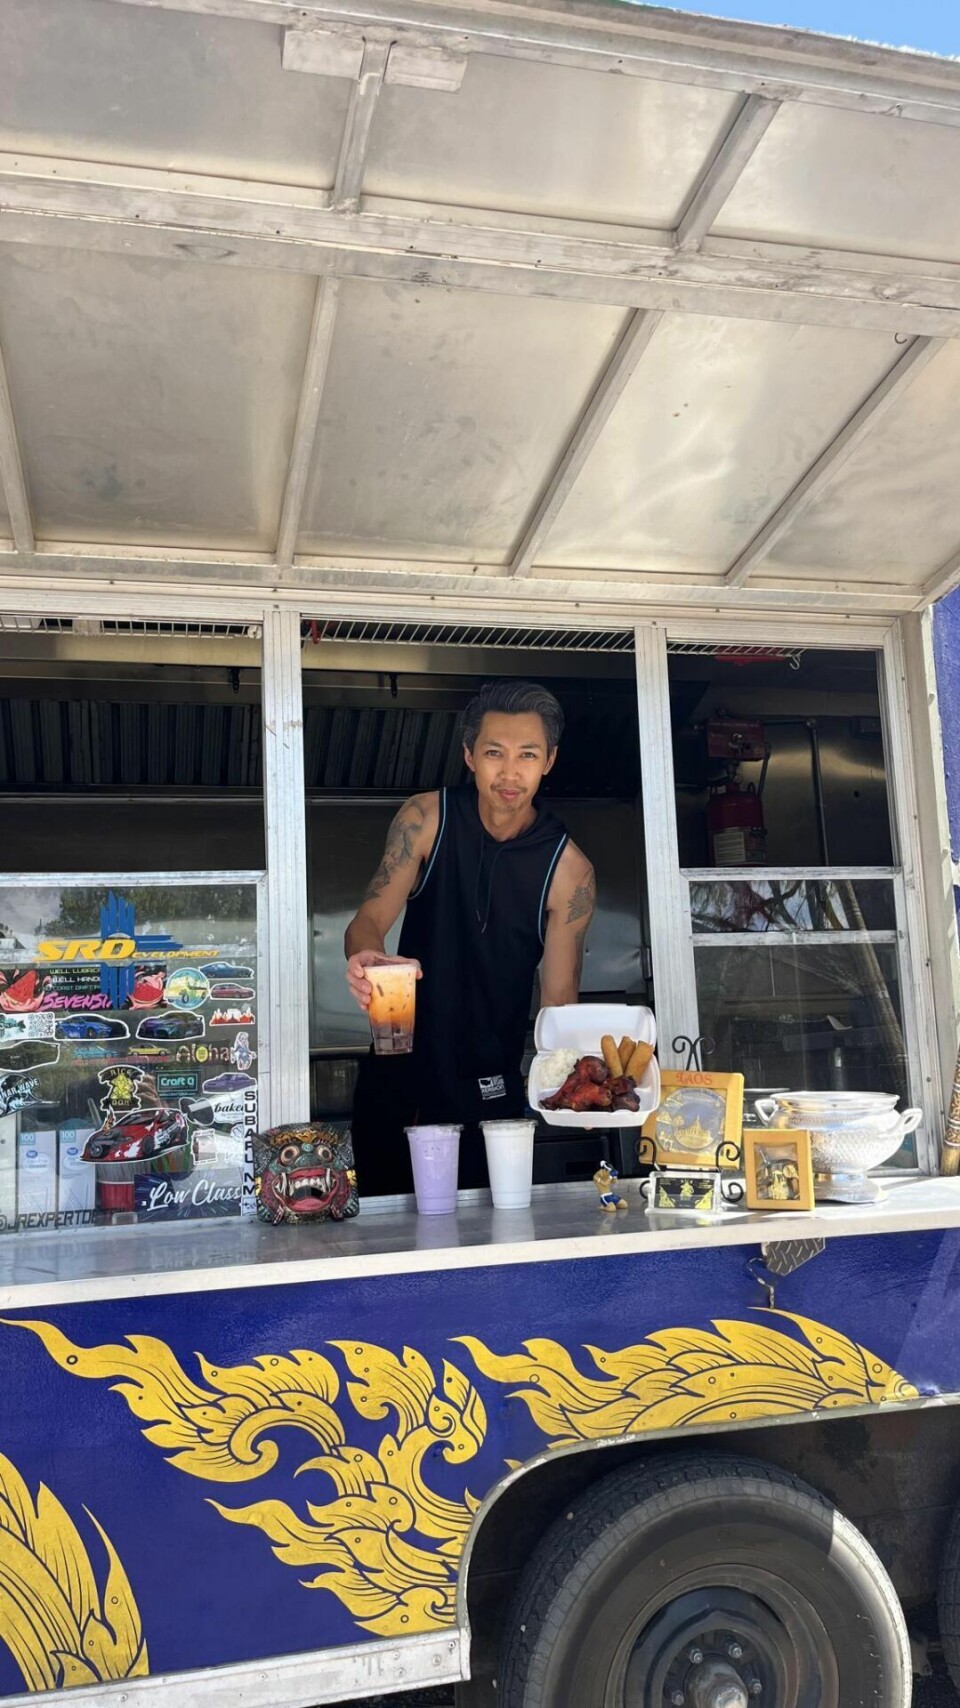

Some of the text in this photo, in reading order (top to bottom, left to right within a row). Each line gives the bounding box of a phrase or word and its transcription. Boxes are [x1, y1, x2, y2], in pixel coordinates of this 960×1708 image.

[161, 1077, 184, 1086] Craft
[676, 1072, 713, 1086] LAOS
[147, 1182, 190, 1211] Low
